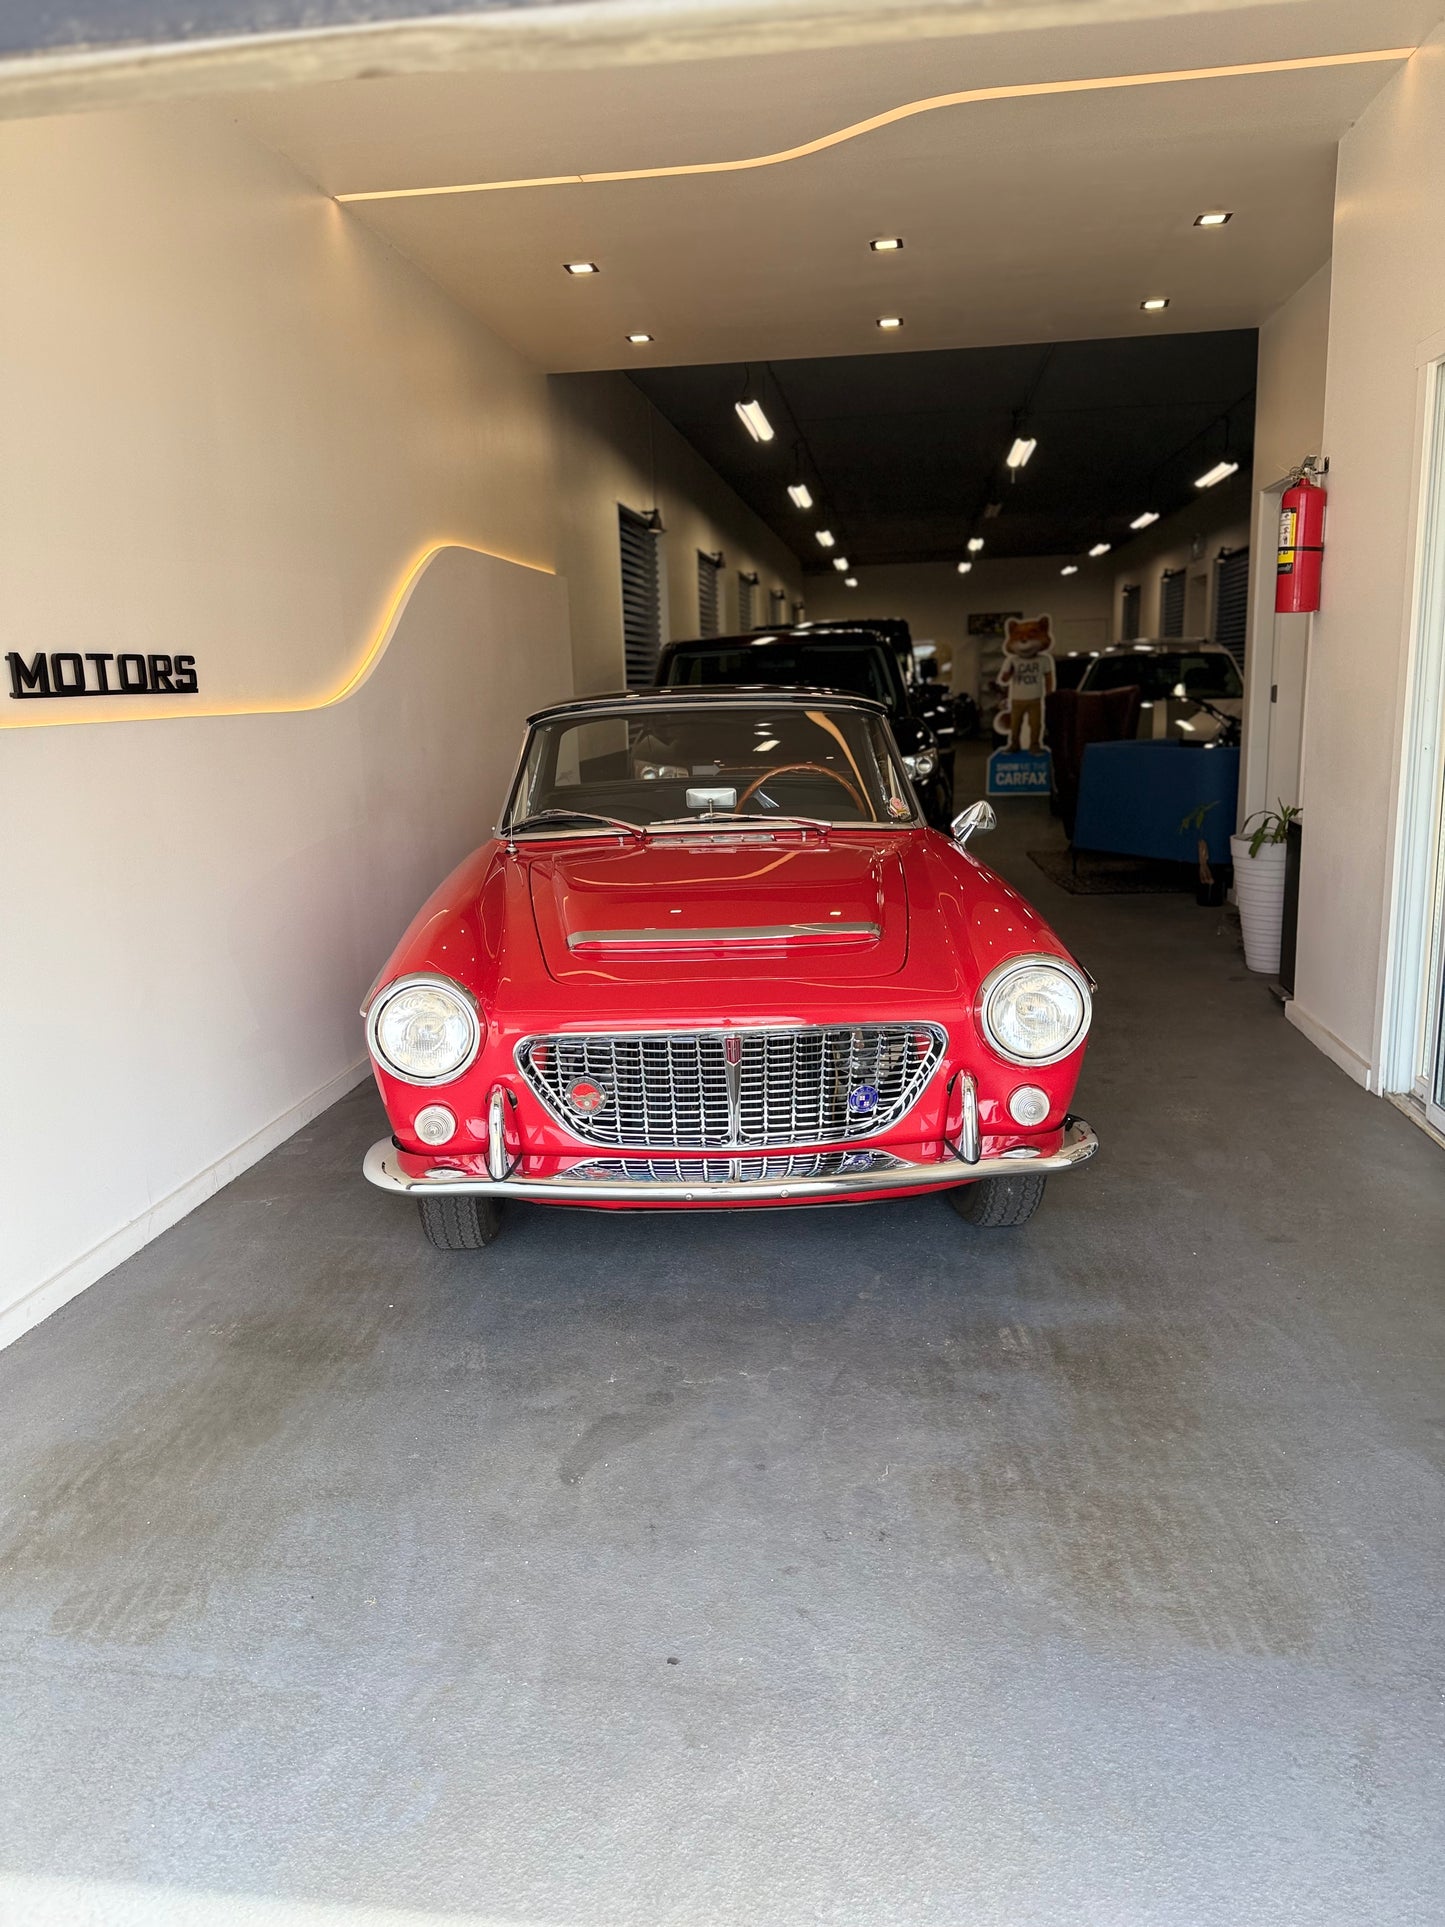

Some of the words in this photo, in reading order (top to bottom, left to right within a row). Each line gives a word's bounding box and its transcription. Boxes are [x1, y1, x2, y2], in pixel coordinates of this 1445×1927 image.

[6, 651, 198, 698] MOTORS
[1018, 662, 1039, 674] CAR
[1016, 674, 1038, 685] FOX
[995, 771, 1047, 786] CARFAX
